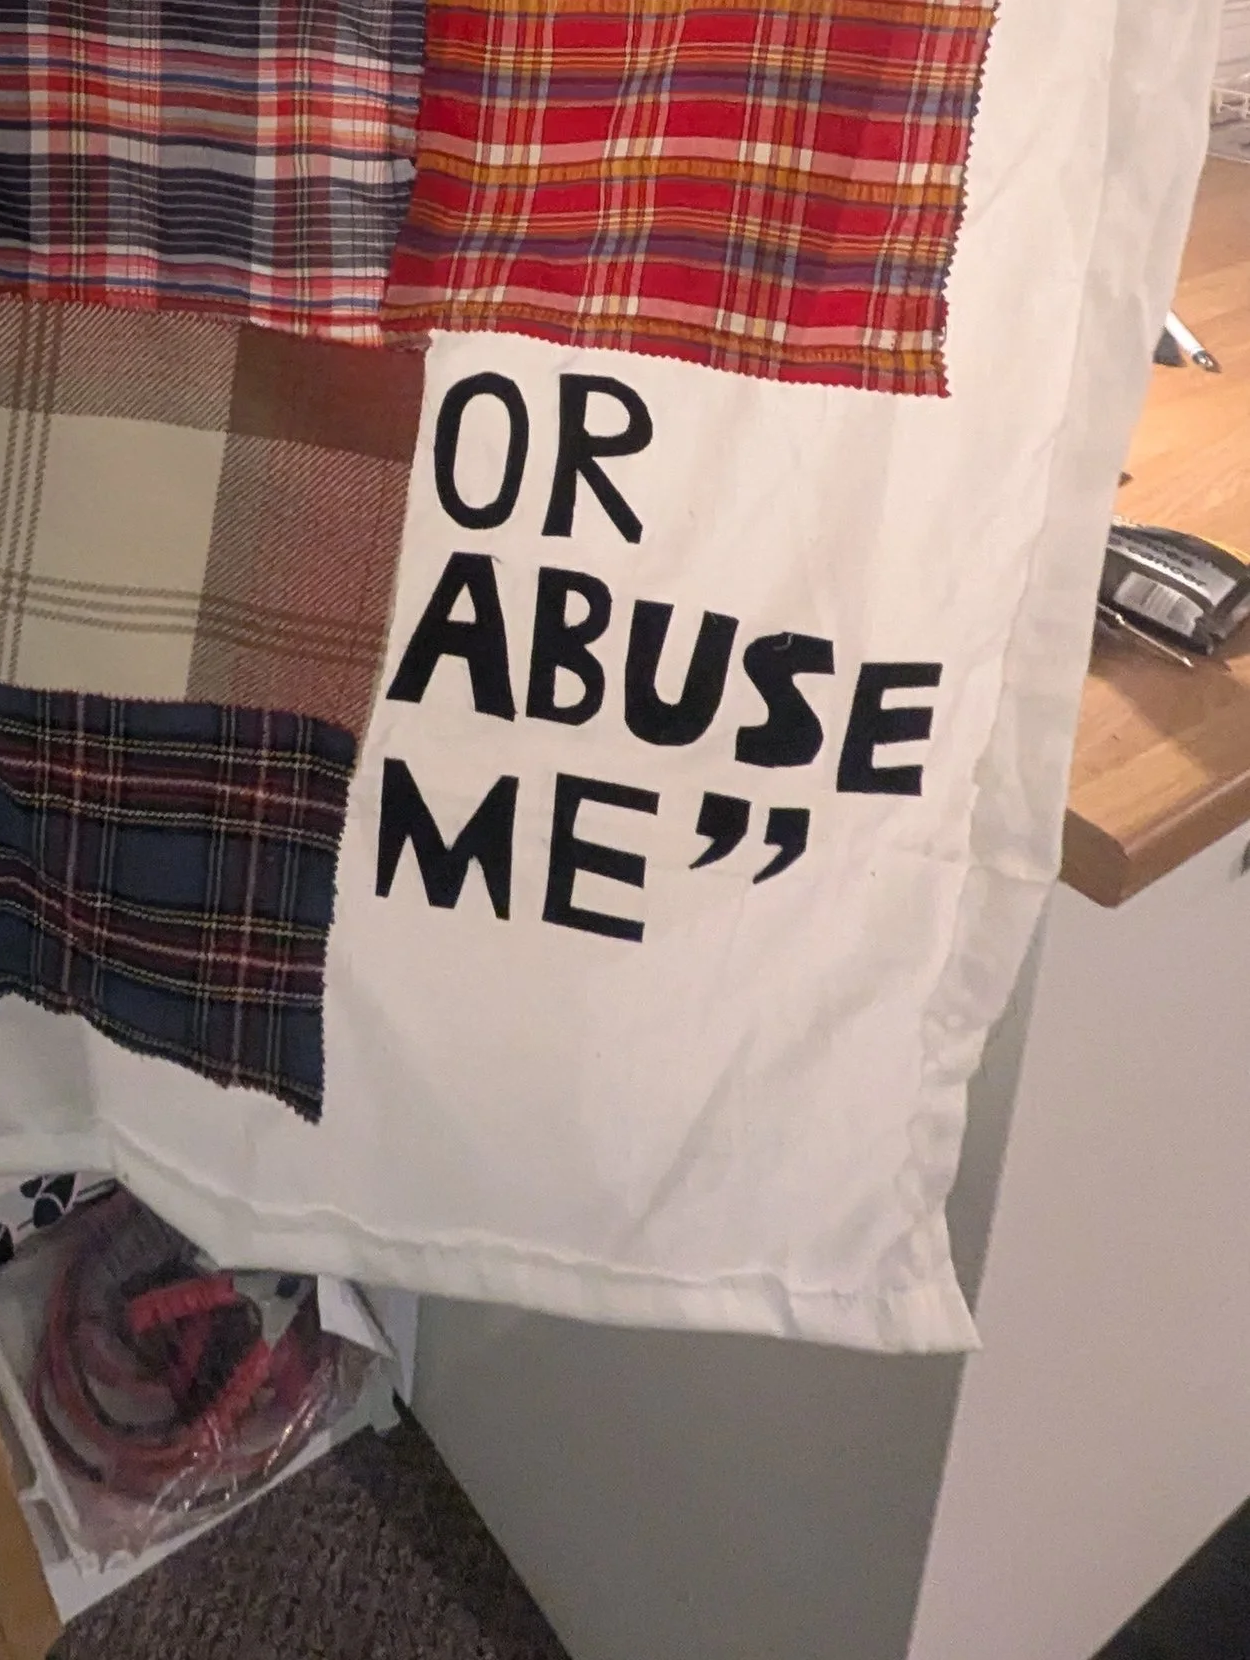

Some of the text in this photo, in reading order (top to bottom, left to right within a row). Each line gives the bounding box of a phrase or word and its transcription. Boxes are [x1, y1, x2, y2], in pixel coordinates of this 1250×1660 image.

[434, 372, 653, 544] OR
[386, 552, 942, 796] ABUSE
[375, 758, 810, 943] ME”
